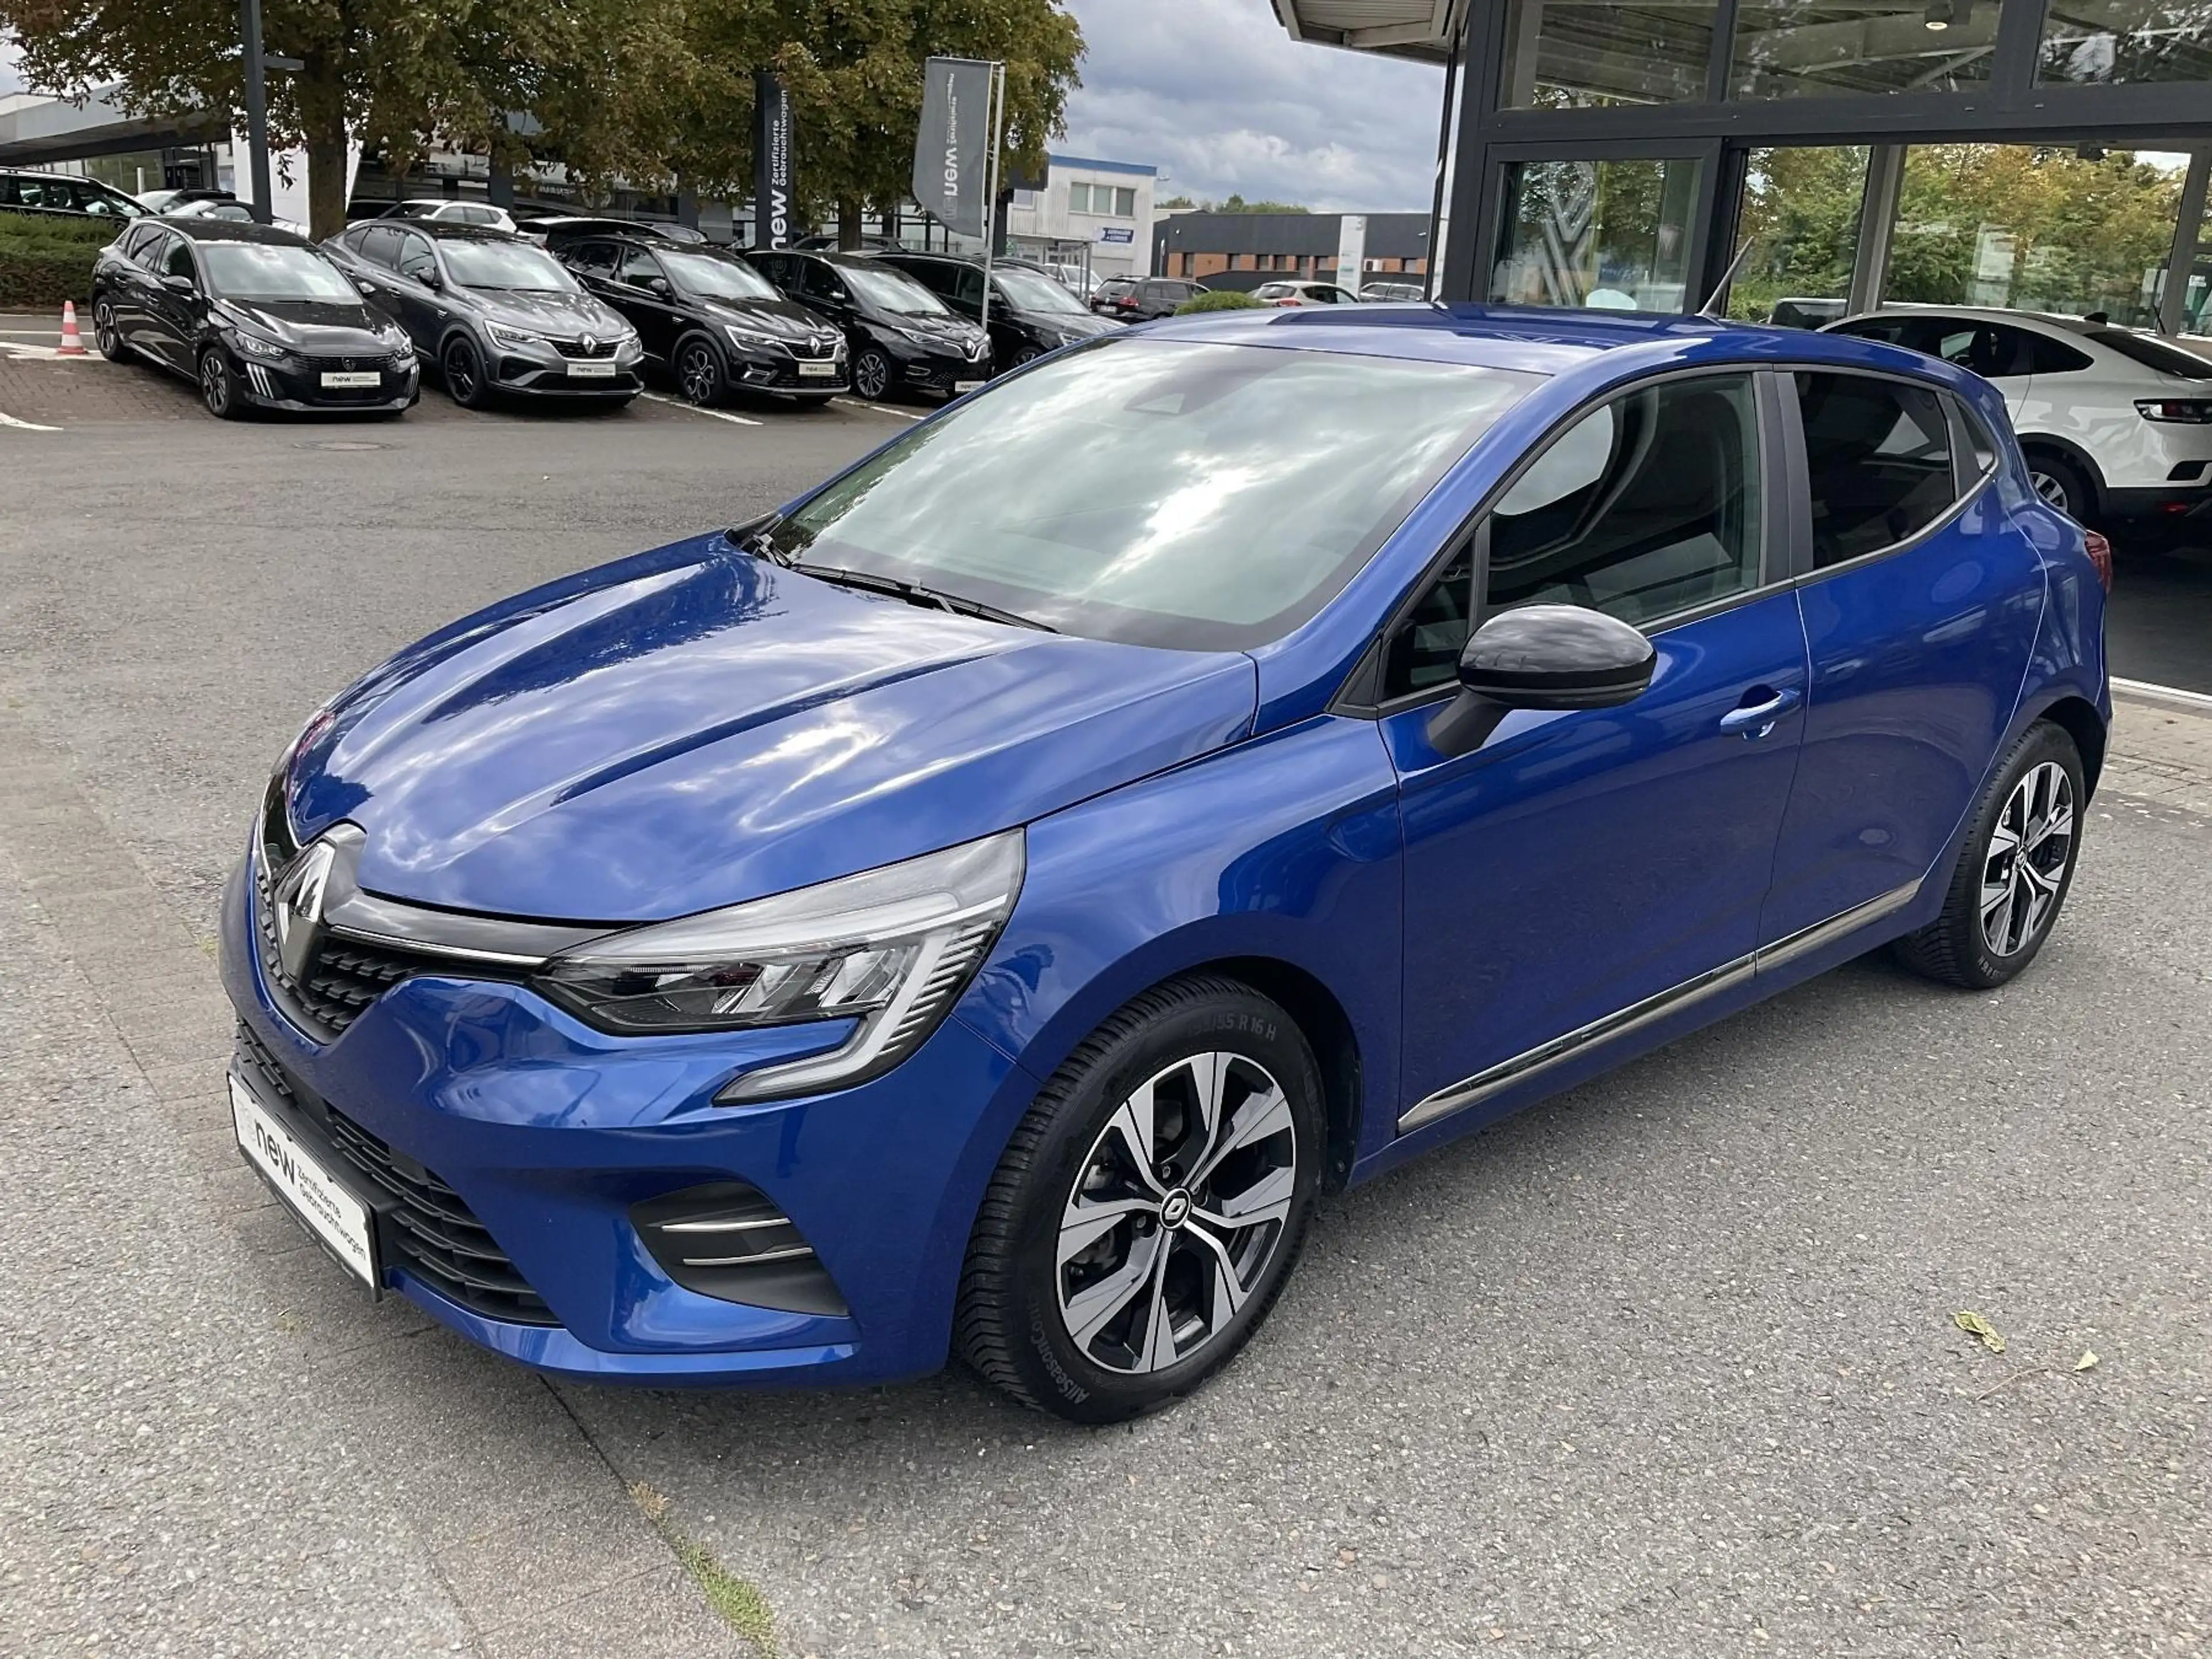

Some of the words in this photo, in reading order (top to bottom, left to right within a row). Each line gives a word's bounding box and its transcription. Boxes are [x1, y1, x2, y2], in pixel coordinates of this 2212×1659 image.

[779, 89, 788, 187] Gebrauchtwagen
[771, 188, 787, 250] new
[297, 1164, 342, 1219] Zertifizierte
[299, 1183, 366, 1261] Gebrauchtwagen
